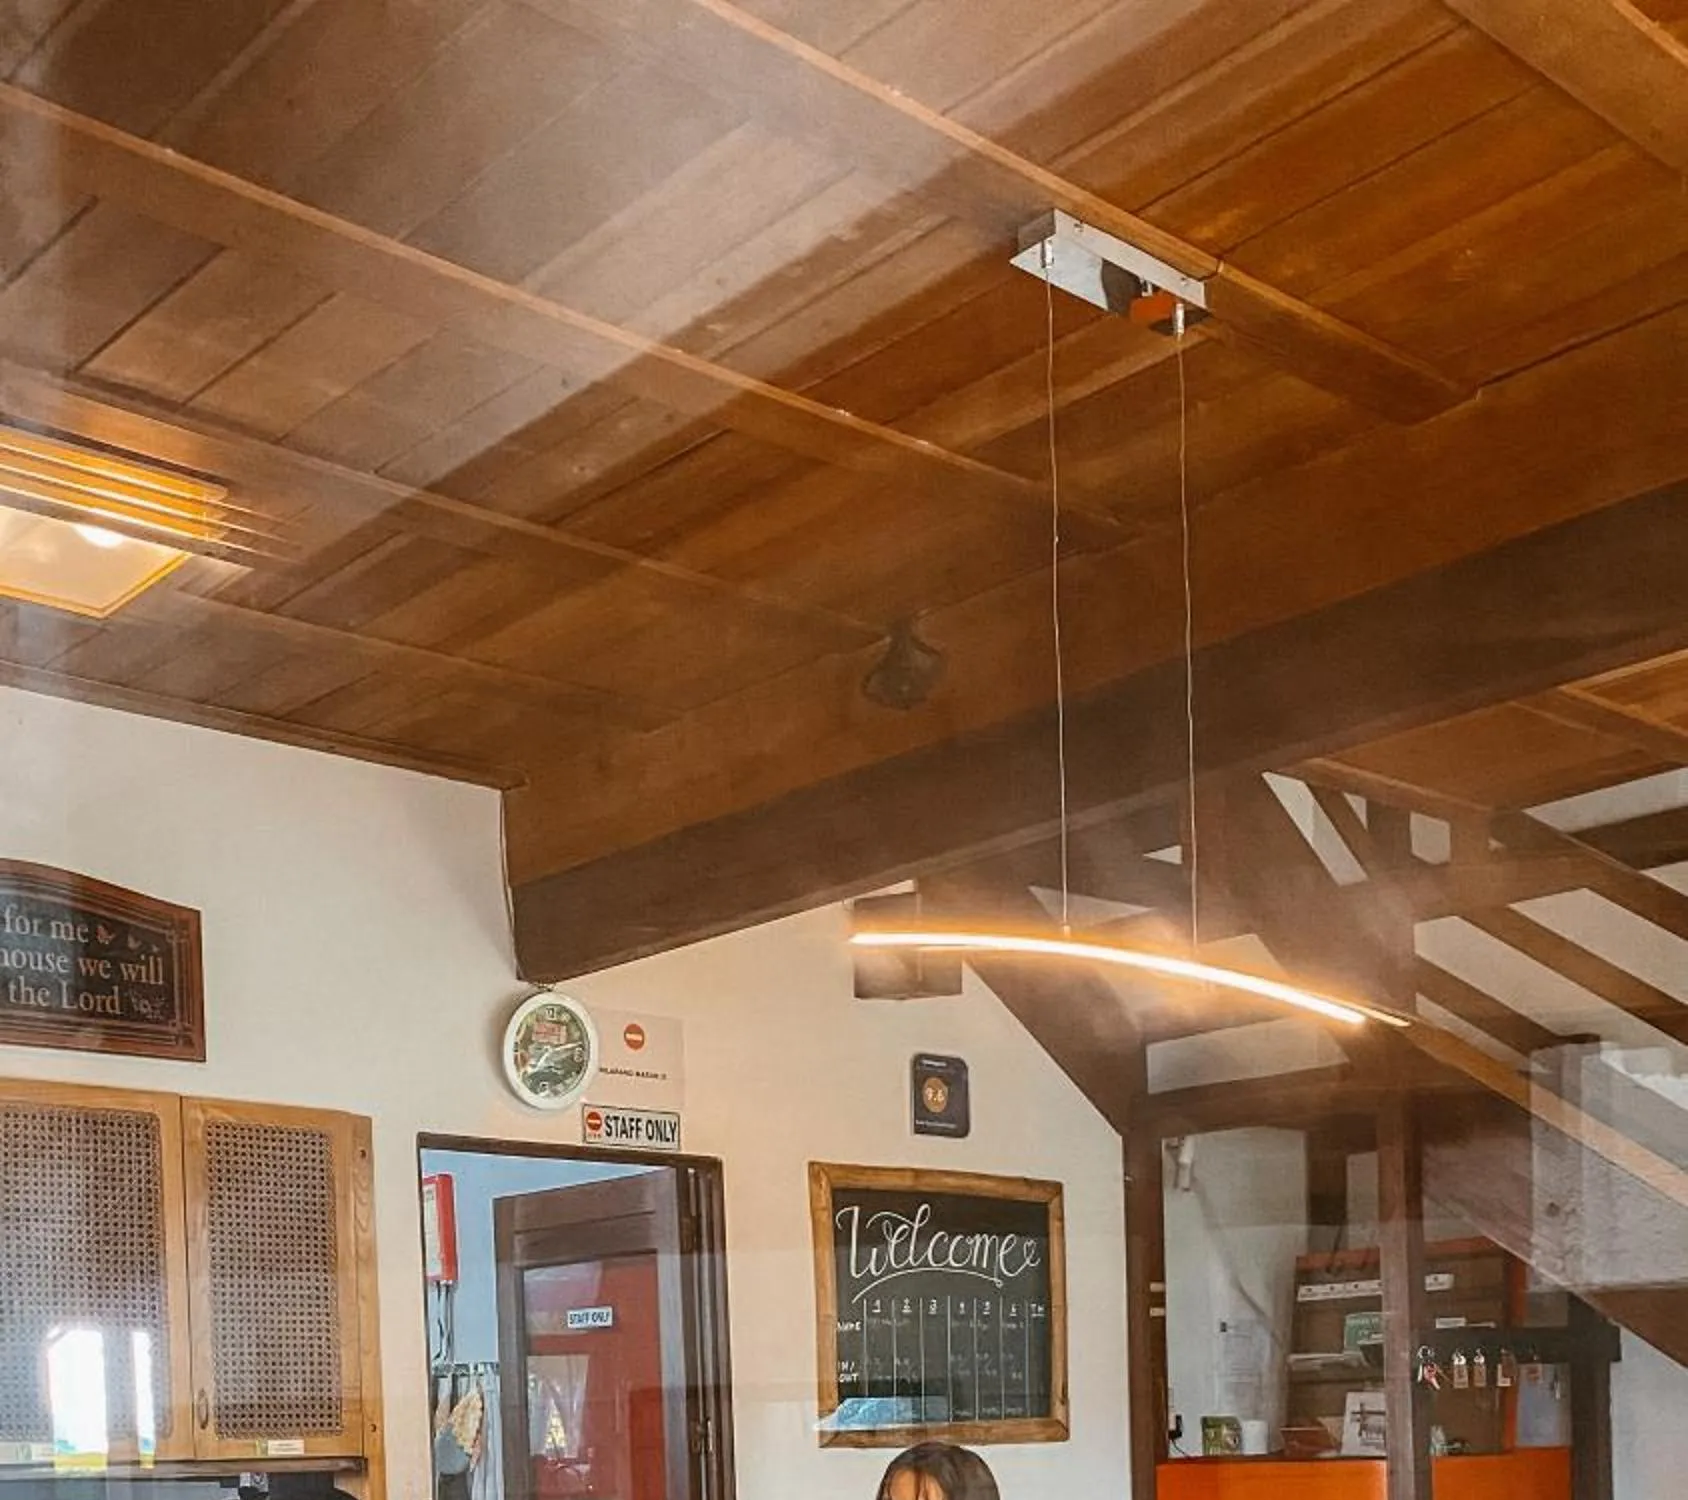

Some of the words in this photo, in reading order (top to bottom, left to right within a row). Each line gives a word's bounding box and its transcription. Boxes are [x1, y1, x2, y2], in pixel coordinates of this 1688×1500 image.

[3, 903, 41, 936] for
[50, 920, 90, 944] me
[77, 956, 112, 979] we
[120, 954, 164, 985] will
[8, 975, 51, 1008] the
[61, 979, 122, 1015] Lord
[604, 1115, 642, 1139] STAFF
[645, 1119, 677, 1142] ONLY
[835, 1203, 1040, 1280] Welcome
